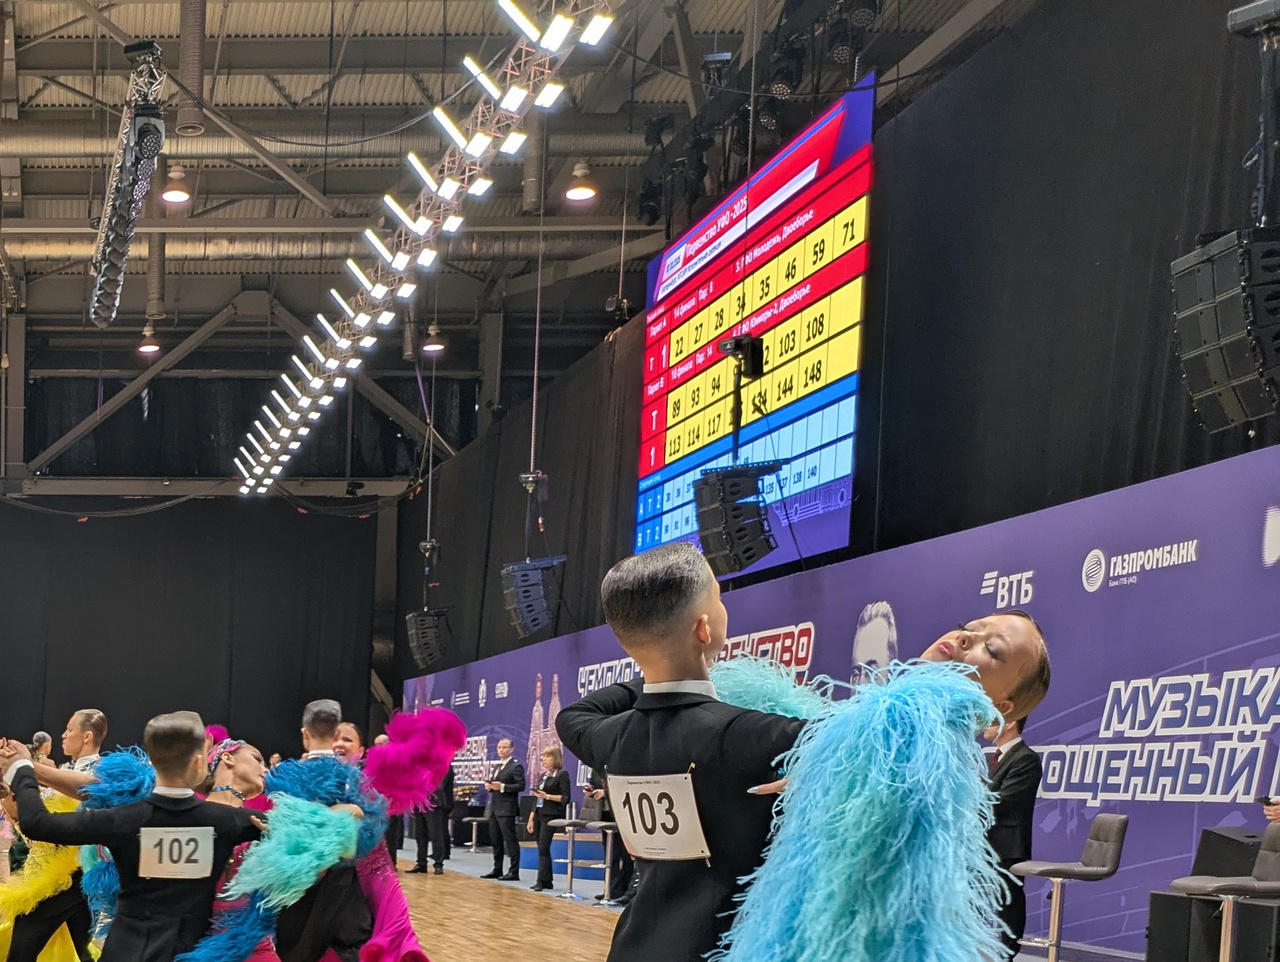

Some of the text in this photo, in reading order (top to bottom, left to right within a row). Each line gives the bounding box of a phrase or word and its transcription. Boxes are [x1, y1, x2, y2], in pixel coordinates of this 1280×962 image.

[686, 223, 718, 258] Первенство
[782, 208, 814, 238] Двоеборье
[675, 218, 856, 357] 22 27 28 34 35 46 59 71
[779, 284, 811, 313] Двоеборье
[672, 313, 824, 420] 89 93 94 103 108
[668, 434, 681, 458] 113
[687, 426, 700, 447] 114
[707, 413, 721, 438] 117
[776, 374, 793, 402] 144
[803, 360, 822, 389] 148
[1109, 539, 1198, 577] ГАЗПРОМБАНК
[996, 570, 1034, 609] ВТБ
[622, 791, 680, 835] 103
[153, 837, 199, 864] 102
